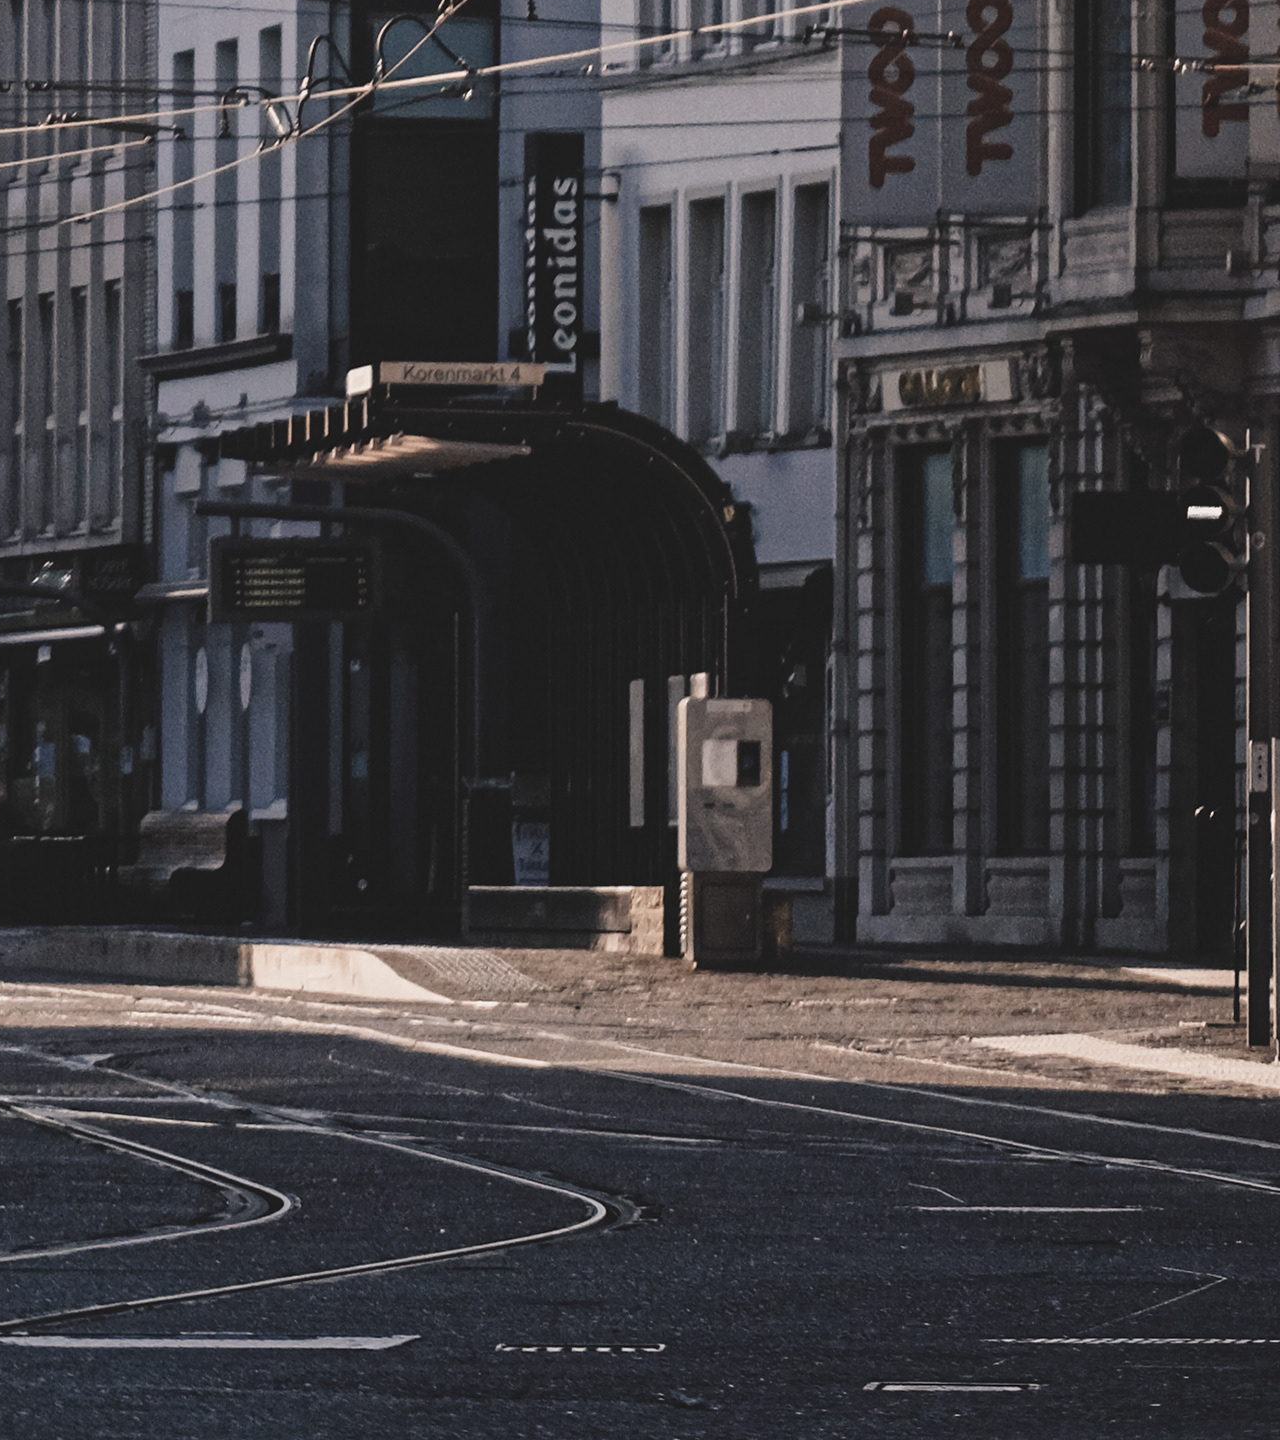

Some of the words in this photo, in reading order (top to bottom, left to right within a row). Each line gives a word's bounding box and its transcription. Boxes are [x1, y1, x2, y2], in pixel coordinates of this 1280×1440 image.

[868, 6, 916, 188] TWOO
[543, 177, 578, 373] Leonidas
[403, 365, 504, 381] Korenmarkt
[510, 366, 521, 382] 4
